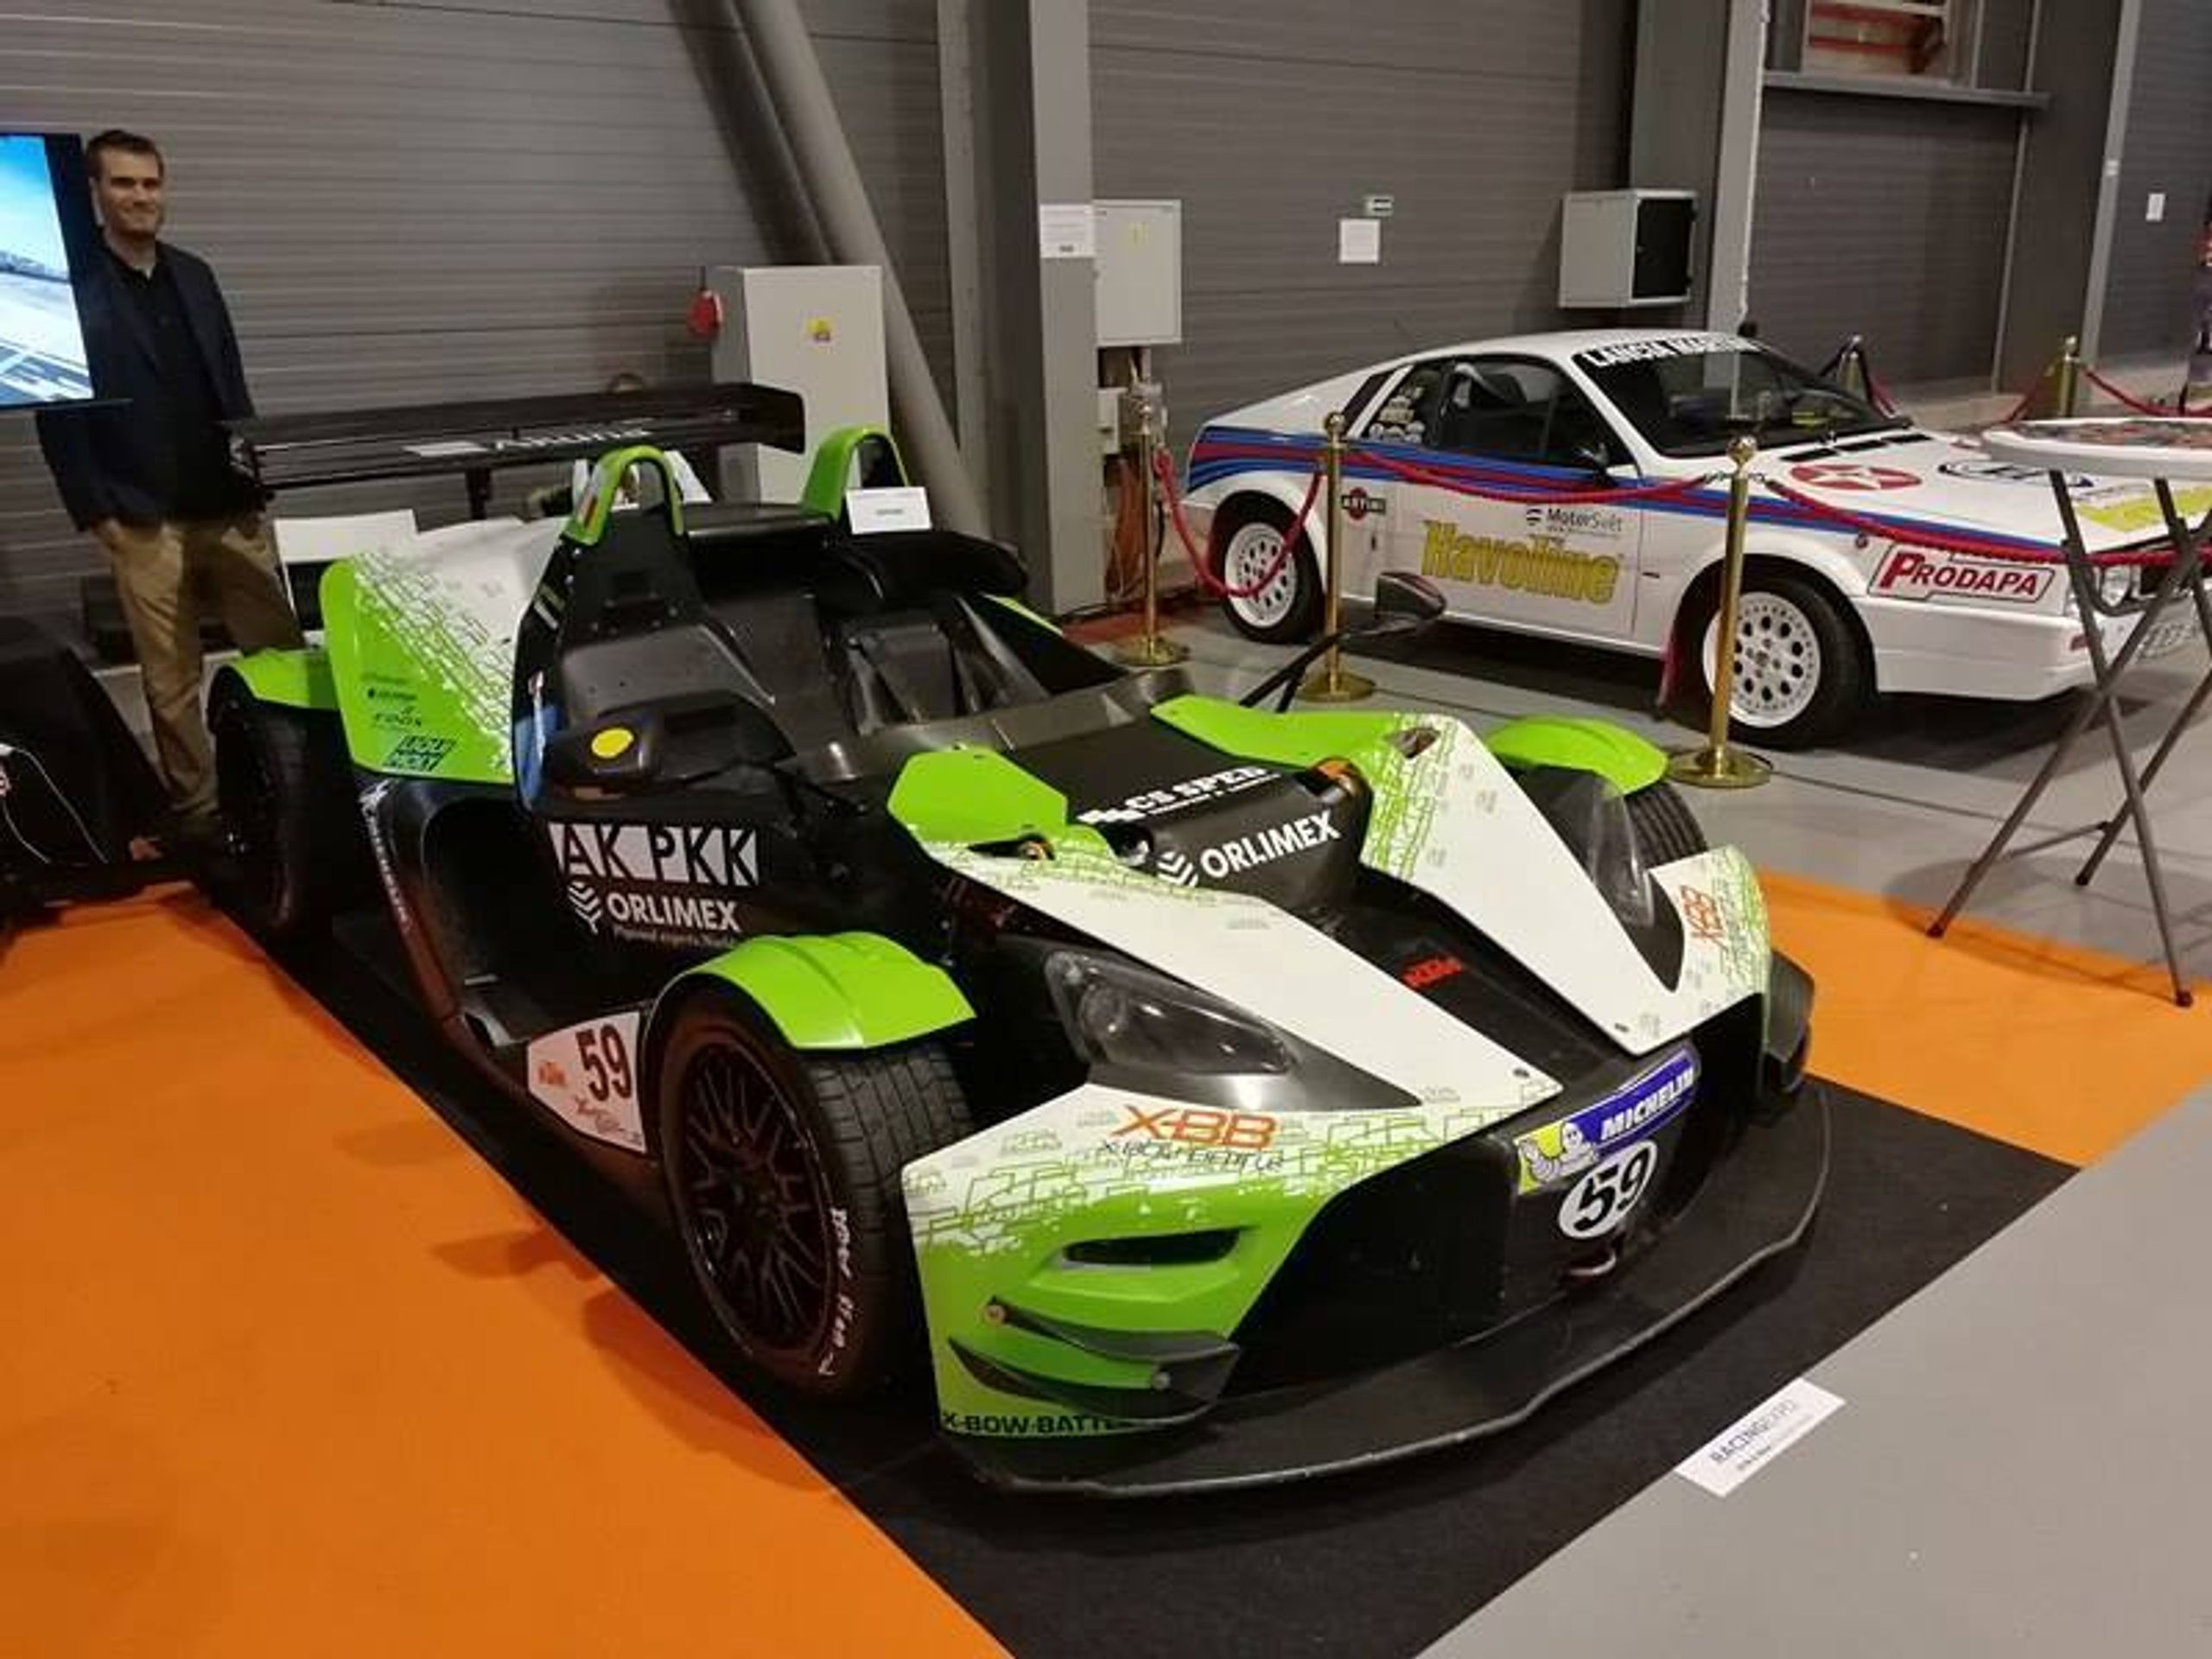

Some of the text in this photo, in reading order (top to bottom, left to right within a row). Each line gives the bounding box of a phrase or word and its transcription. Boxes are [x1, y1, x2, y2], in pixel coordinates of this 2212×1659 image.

[1879, 550, 2037, 596] PRODAPA
[1199, 810, 1340, 880] ORLIMEX
[607, 891, 742, 934] ORLIMEX
[575, 1023, 632, 1103] 59
[1600, 1066, 1694, 1141] MICHELIN
[1572, 1146, 1650, 1232] 59
